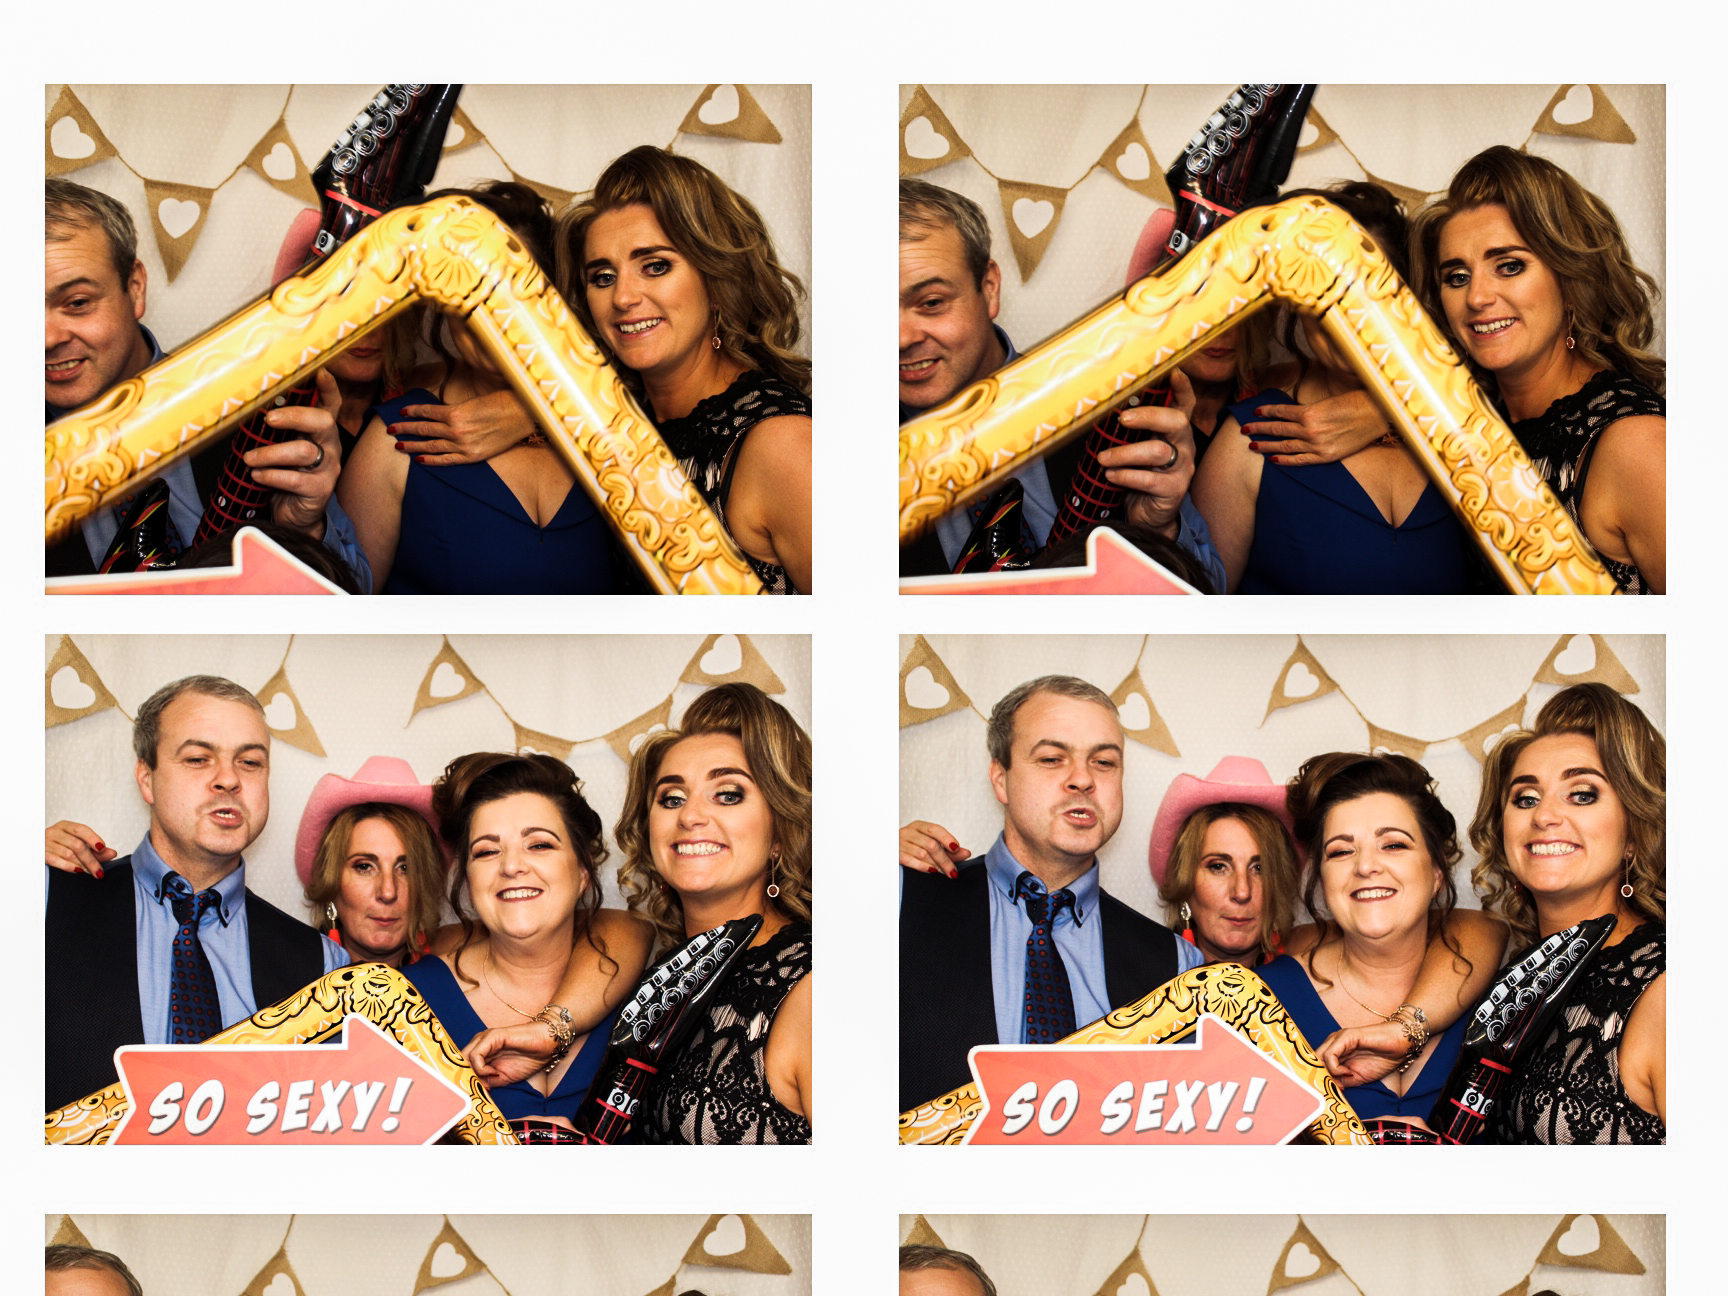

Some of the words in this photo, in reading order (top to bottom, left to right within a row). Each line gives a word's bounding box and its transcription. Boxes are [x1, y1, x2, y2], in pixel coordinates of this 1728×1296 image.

[147, 1078, 226, 1136] SO
[245, 1076, 415, 1136] SEXY!
[1001, 1078, 1080, 1136] SO
[1099, 1076, 1269, 1136] SEXY!
